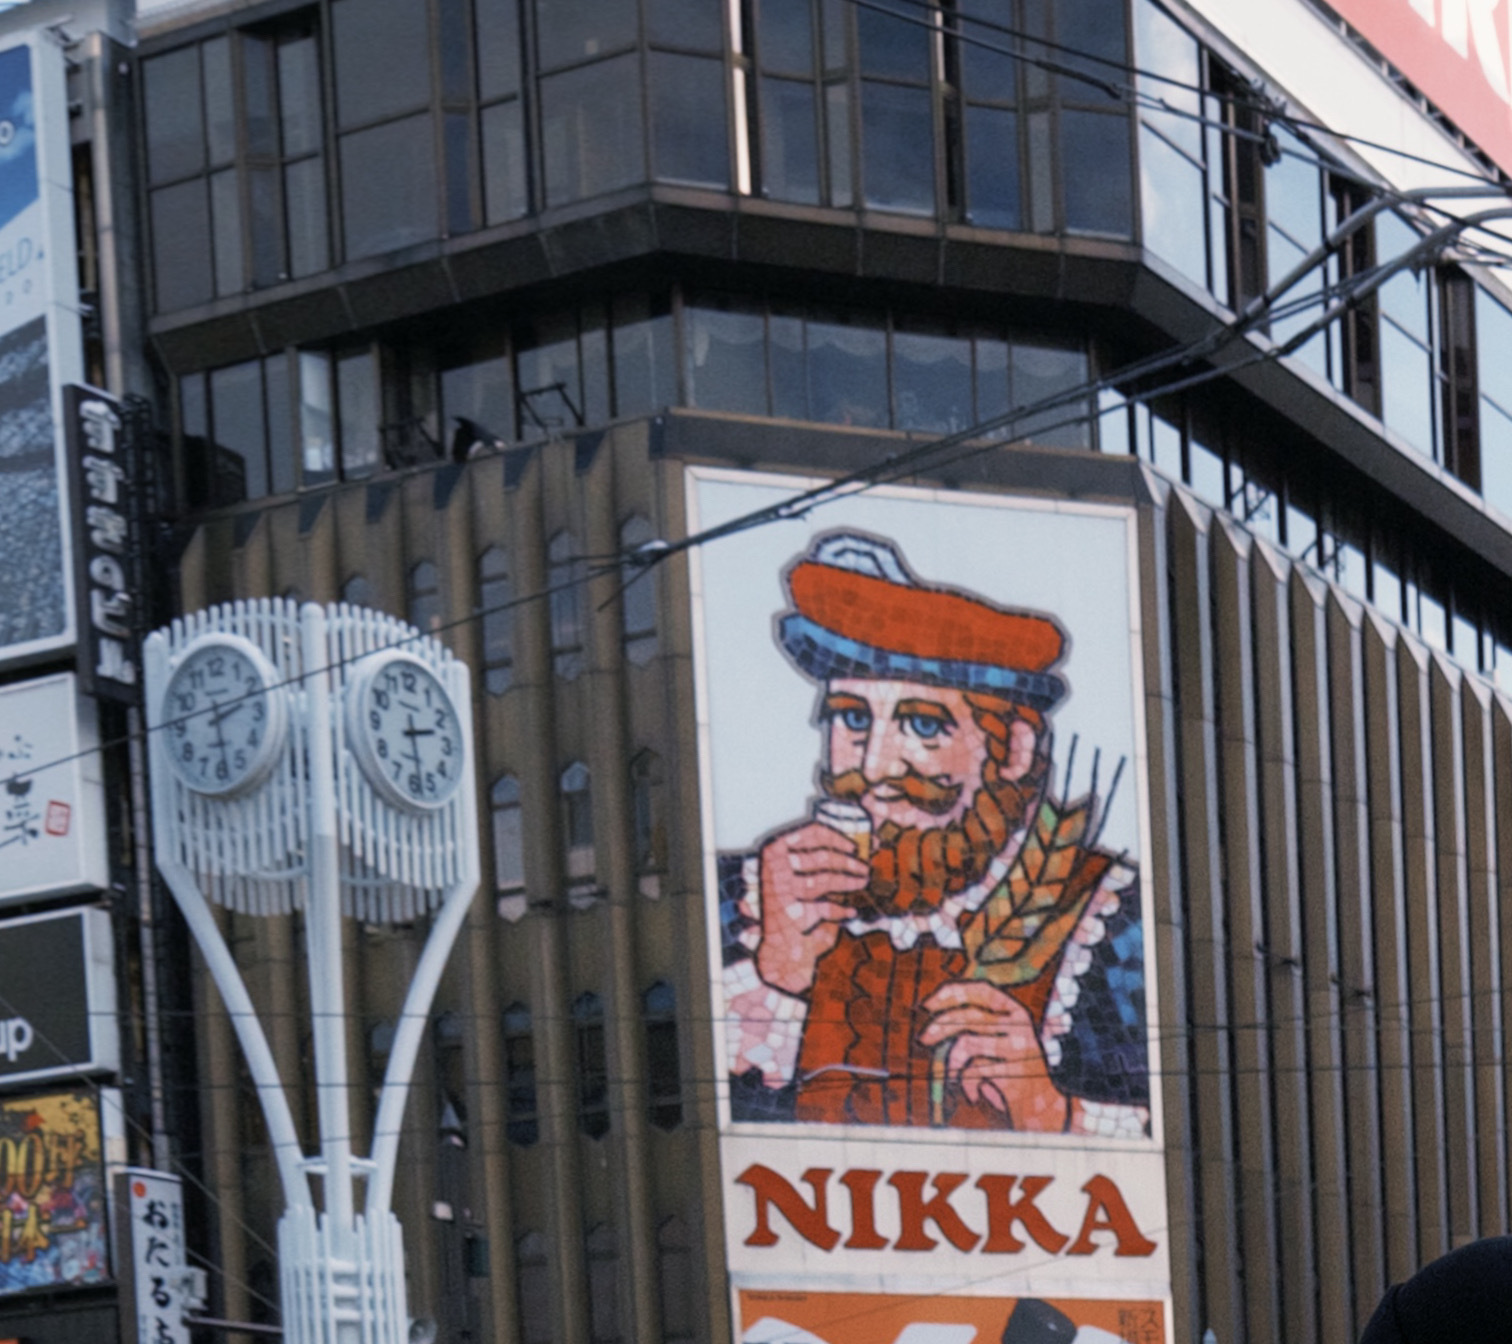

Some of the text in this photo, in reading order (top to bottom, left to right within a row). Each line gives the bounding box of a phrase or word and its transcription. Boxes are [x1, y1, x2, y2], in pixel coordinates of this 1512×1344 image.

[79, 399, 136, 685] すすきのビル
[734, 1163, 1158, 1257] NIKKA
